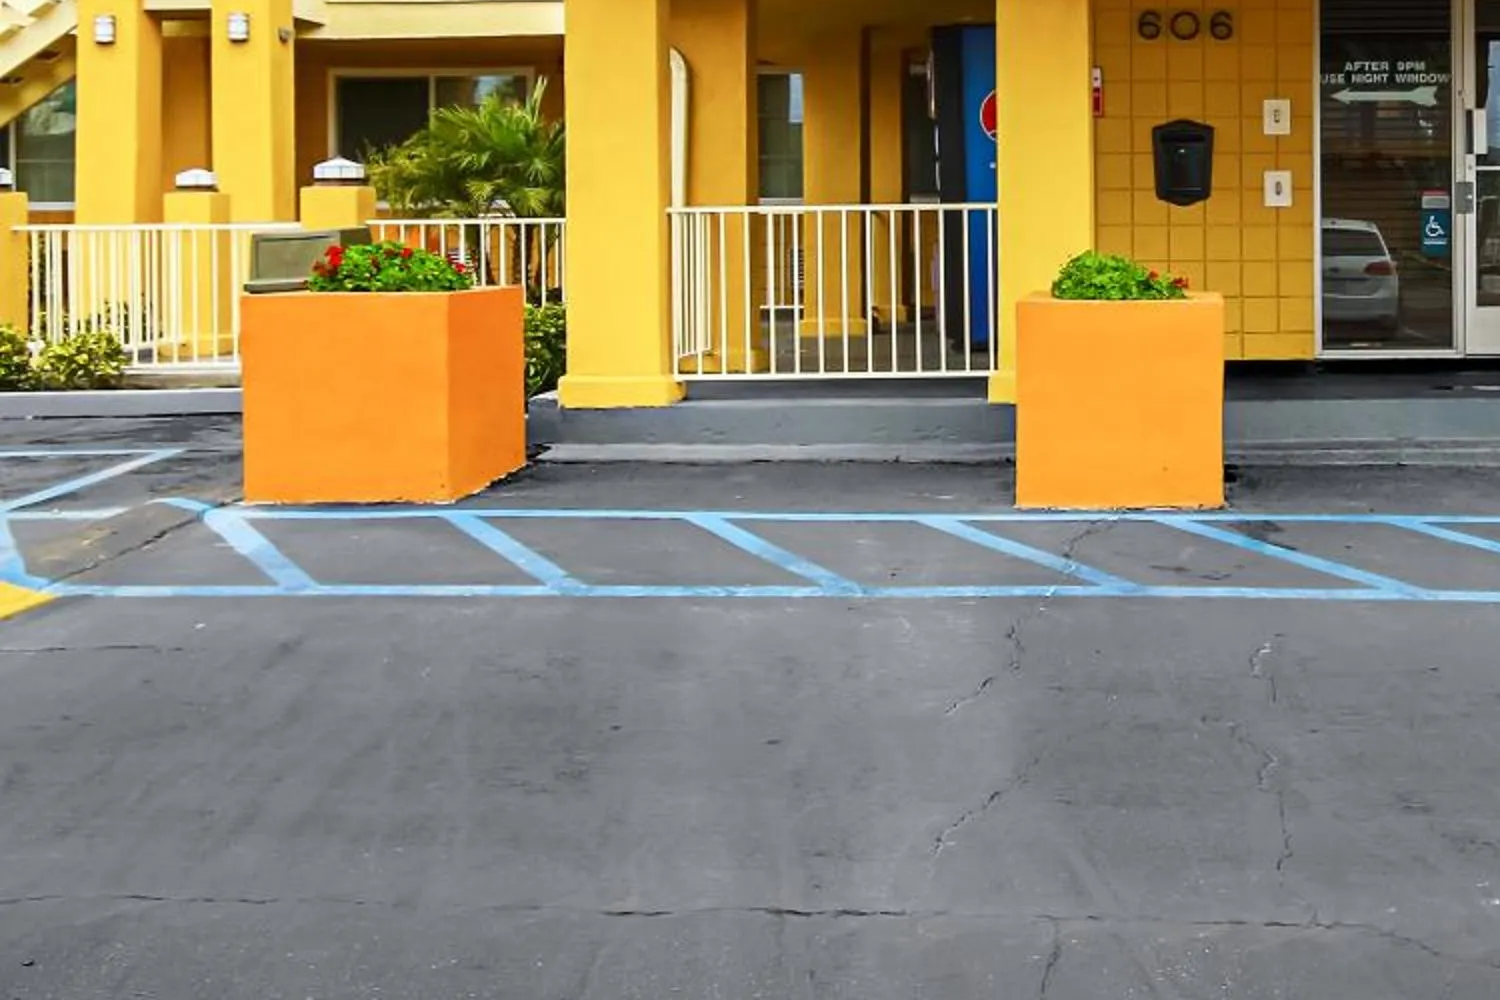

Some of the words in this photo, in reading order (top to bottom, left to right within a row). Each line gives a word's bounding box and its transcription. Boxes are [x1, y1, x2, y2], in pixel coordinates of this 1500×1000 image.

[1137, 9, 1233, 41] 606
[1344, 61, 1389, 71] AFTER
[1351, 73, 1389, 83] NIGHT
[1395, 73, 1451, 83] WINDOW
